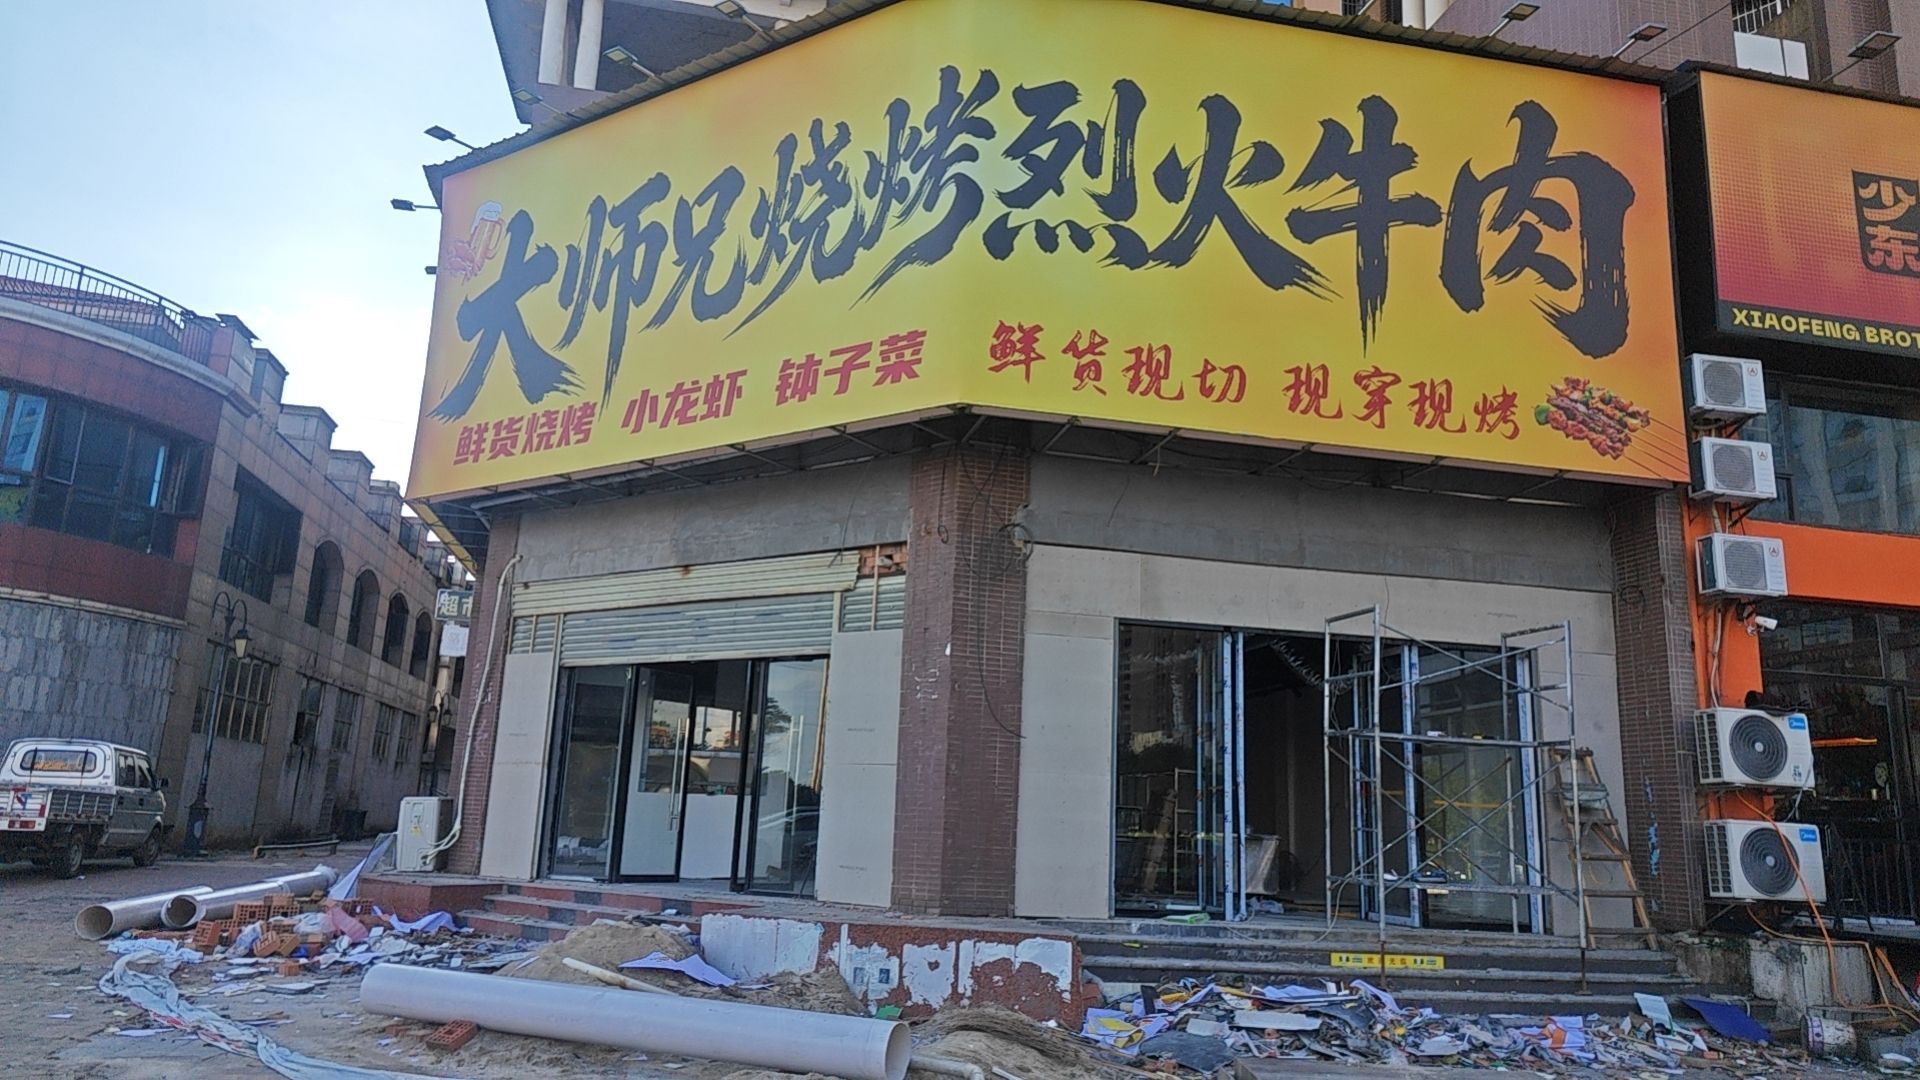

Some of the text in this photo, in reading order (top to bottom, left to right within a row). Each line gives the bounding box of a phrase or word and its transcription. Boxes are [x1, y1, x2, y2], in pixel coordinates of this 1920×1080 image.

[988, 320, 1520, 441] 鲜货现切 现穿现烤
[1732, 307, 1860, 341] XIAOFENG
[453, 329, 928, 466] 鲜货烧烤 小龙虾 钵子菜
